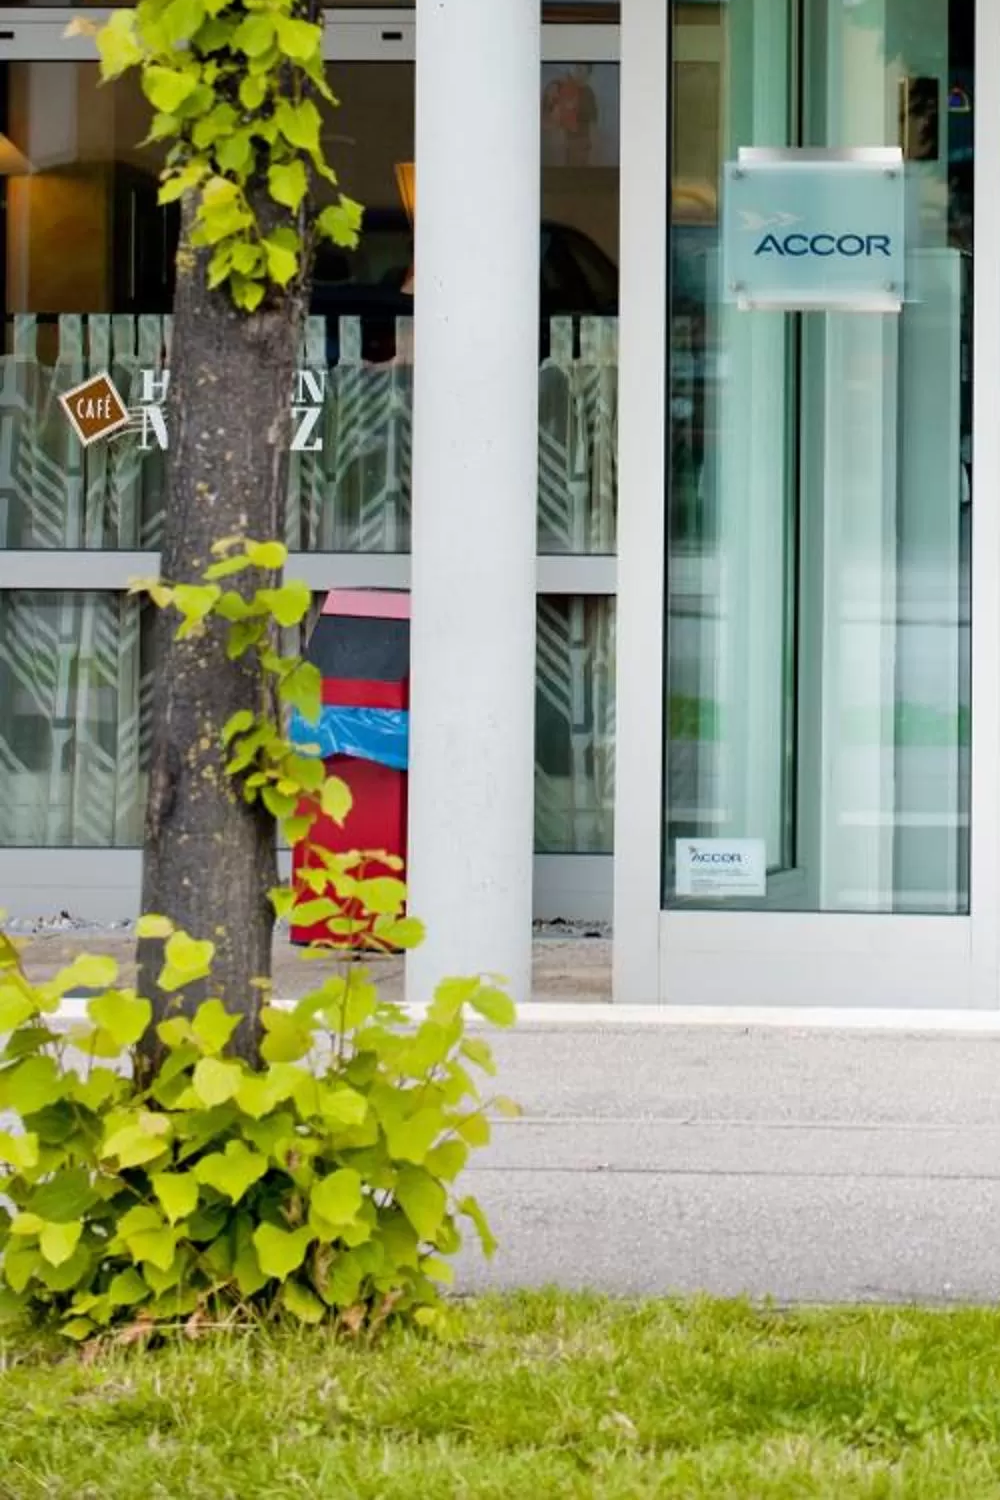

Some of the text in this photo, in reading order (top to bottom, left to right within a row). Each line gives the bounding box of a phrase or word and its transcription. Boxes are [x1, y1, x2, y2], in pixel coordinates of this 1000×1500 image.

[754, 233, 892, 257] ACCOR
[76, 393, 111, 419] CAFÉ
[691, 852, 742, 863] ACCOR
